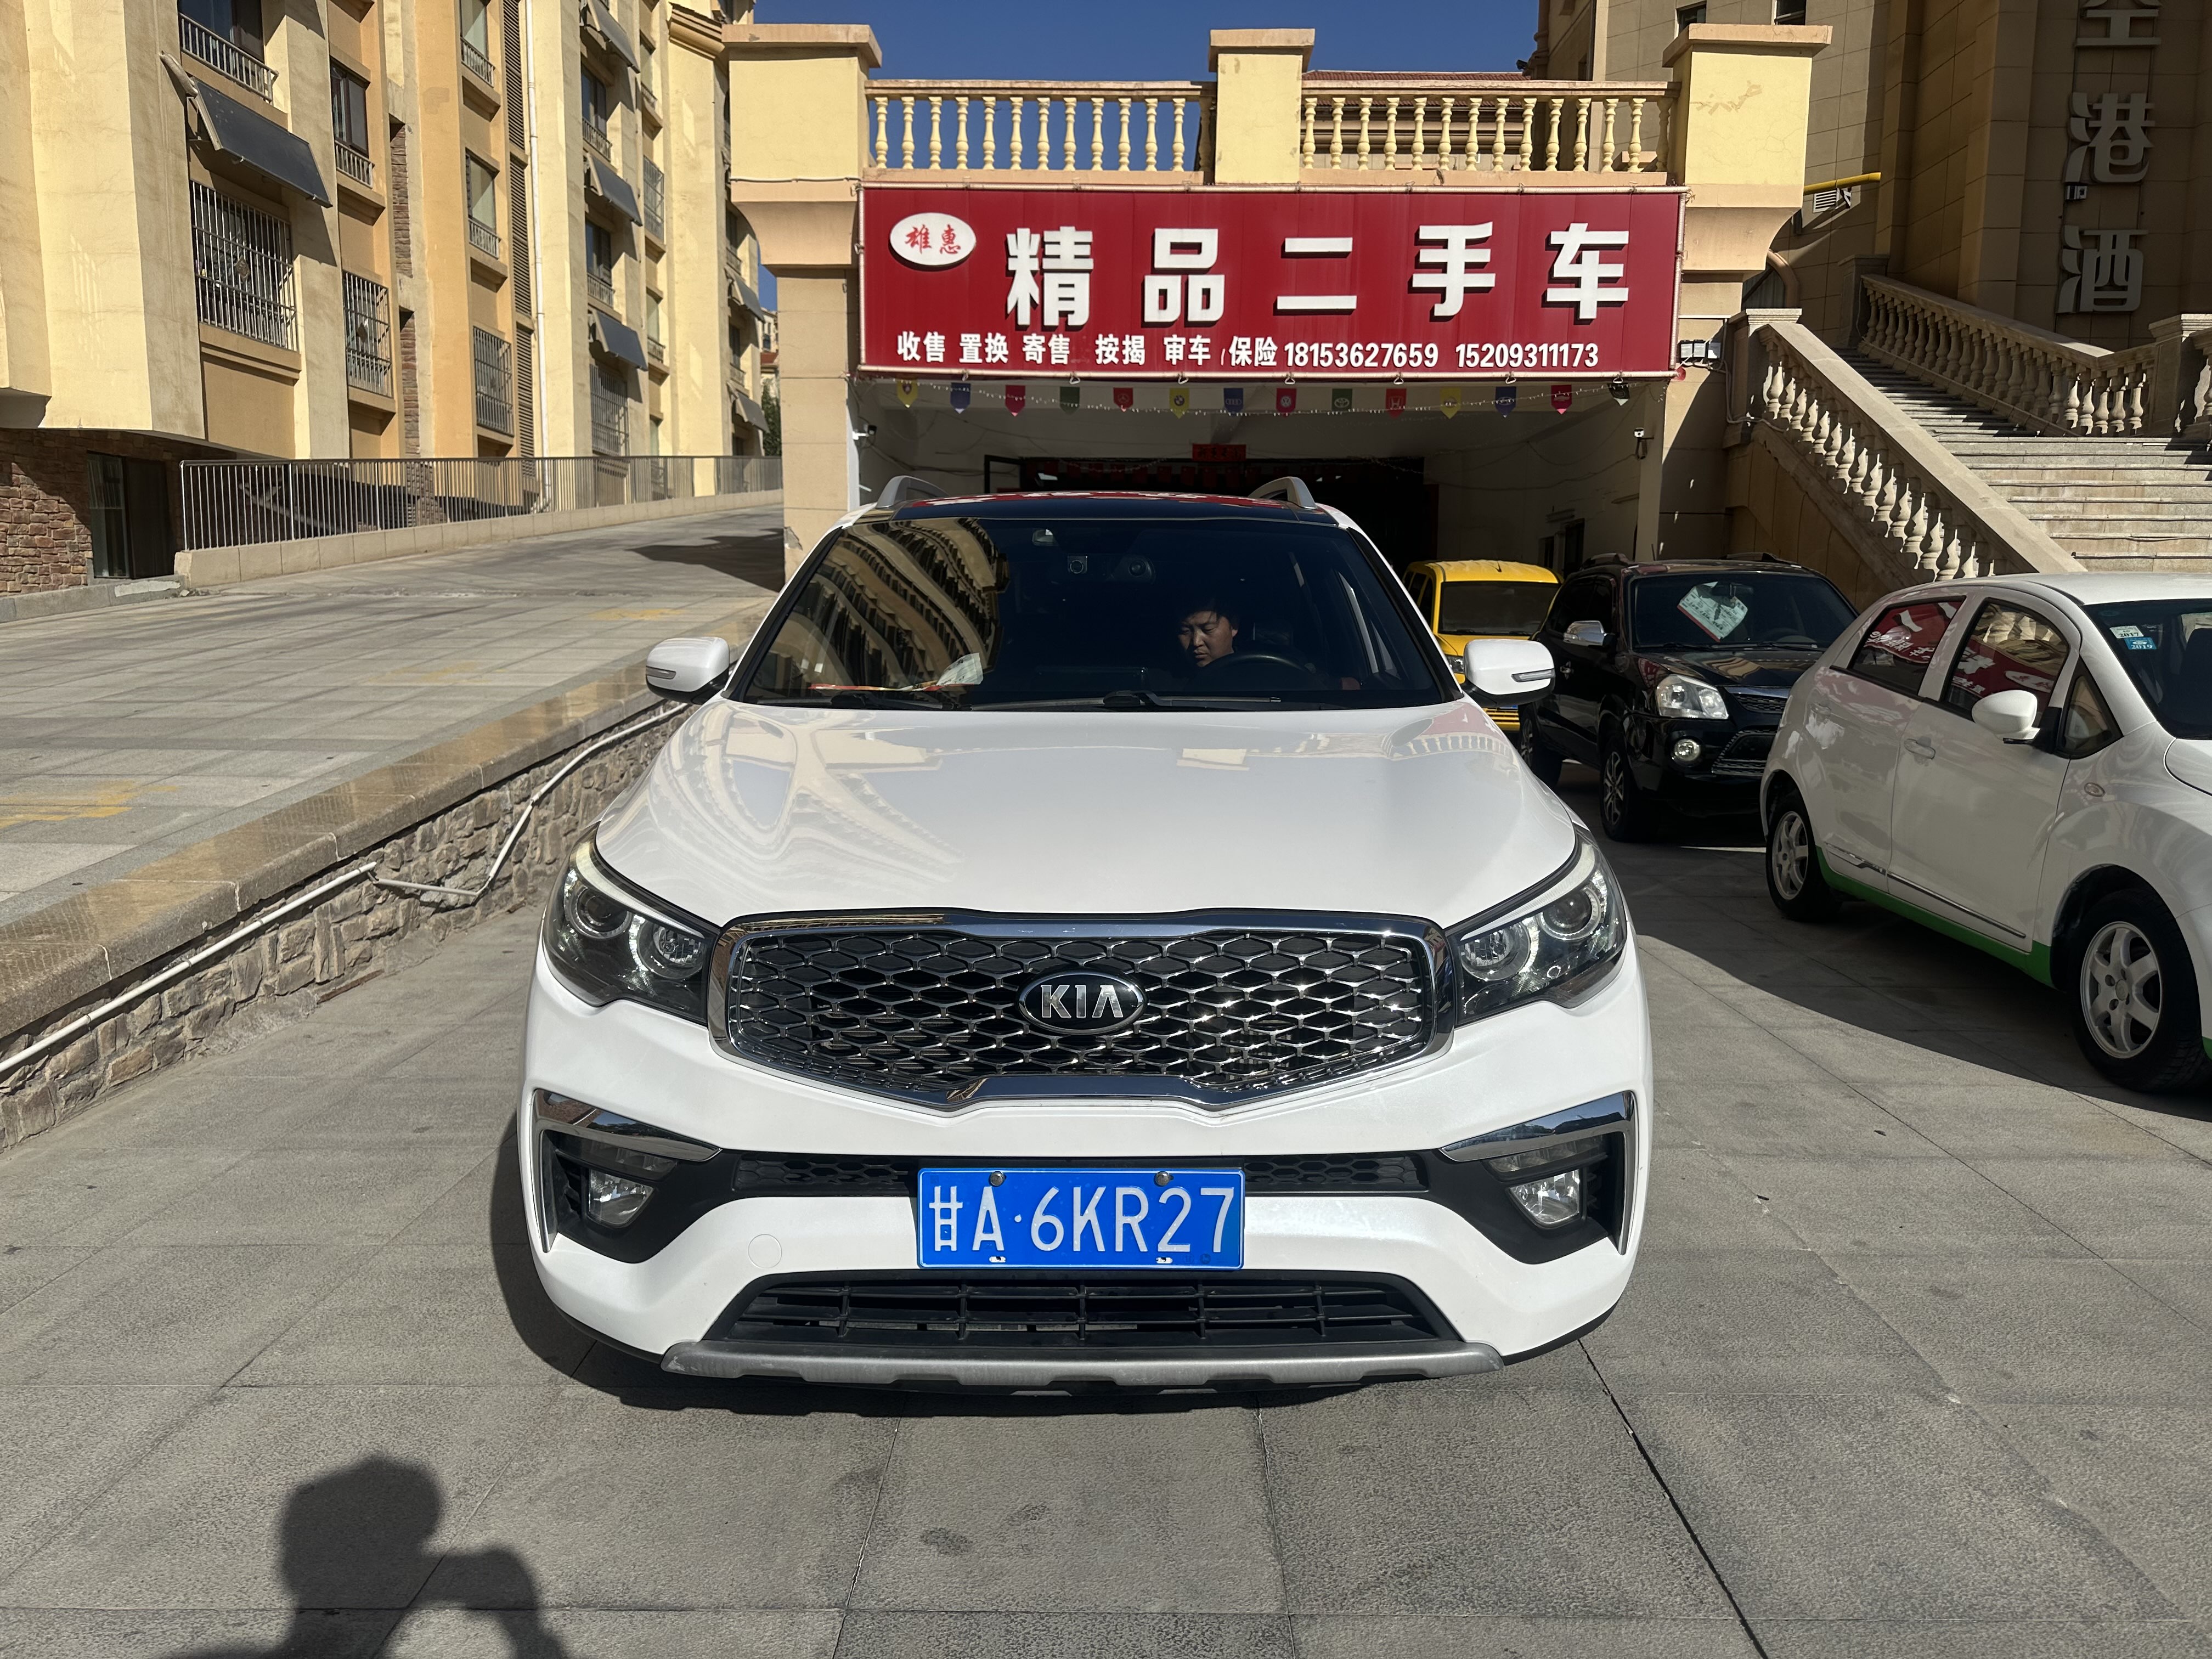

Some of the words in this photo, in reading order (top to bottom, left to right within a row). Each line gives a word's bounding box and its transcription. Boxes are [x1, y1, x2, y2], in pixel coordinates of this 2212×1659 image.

[905, 224, 961, 255] 雄惠
[1006, 221, 1629, 326] 精品二手车
[897, 331, 946, 363] 收售
[959, 332, 1009, 364] 置换
[1022, 332, 1070, 365] 寄售
[1095, 333, 1146, 365] 按揭
[1164, 334, 1211, 365] 审车
[1228, 335, 1278, 367] 保险
[1284, 342, 1439, 368] 18153627659
[1455, 342, 1599, 368] 15209311173
[1040, 985, 1124, 1018] KIA
[929, 1186, 1234, 1252] 甘A·6KR27
